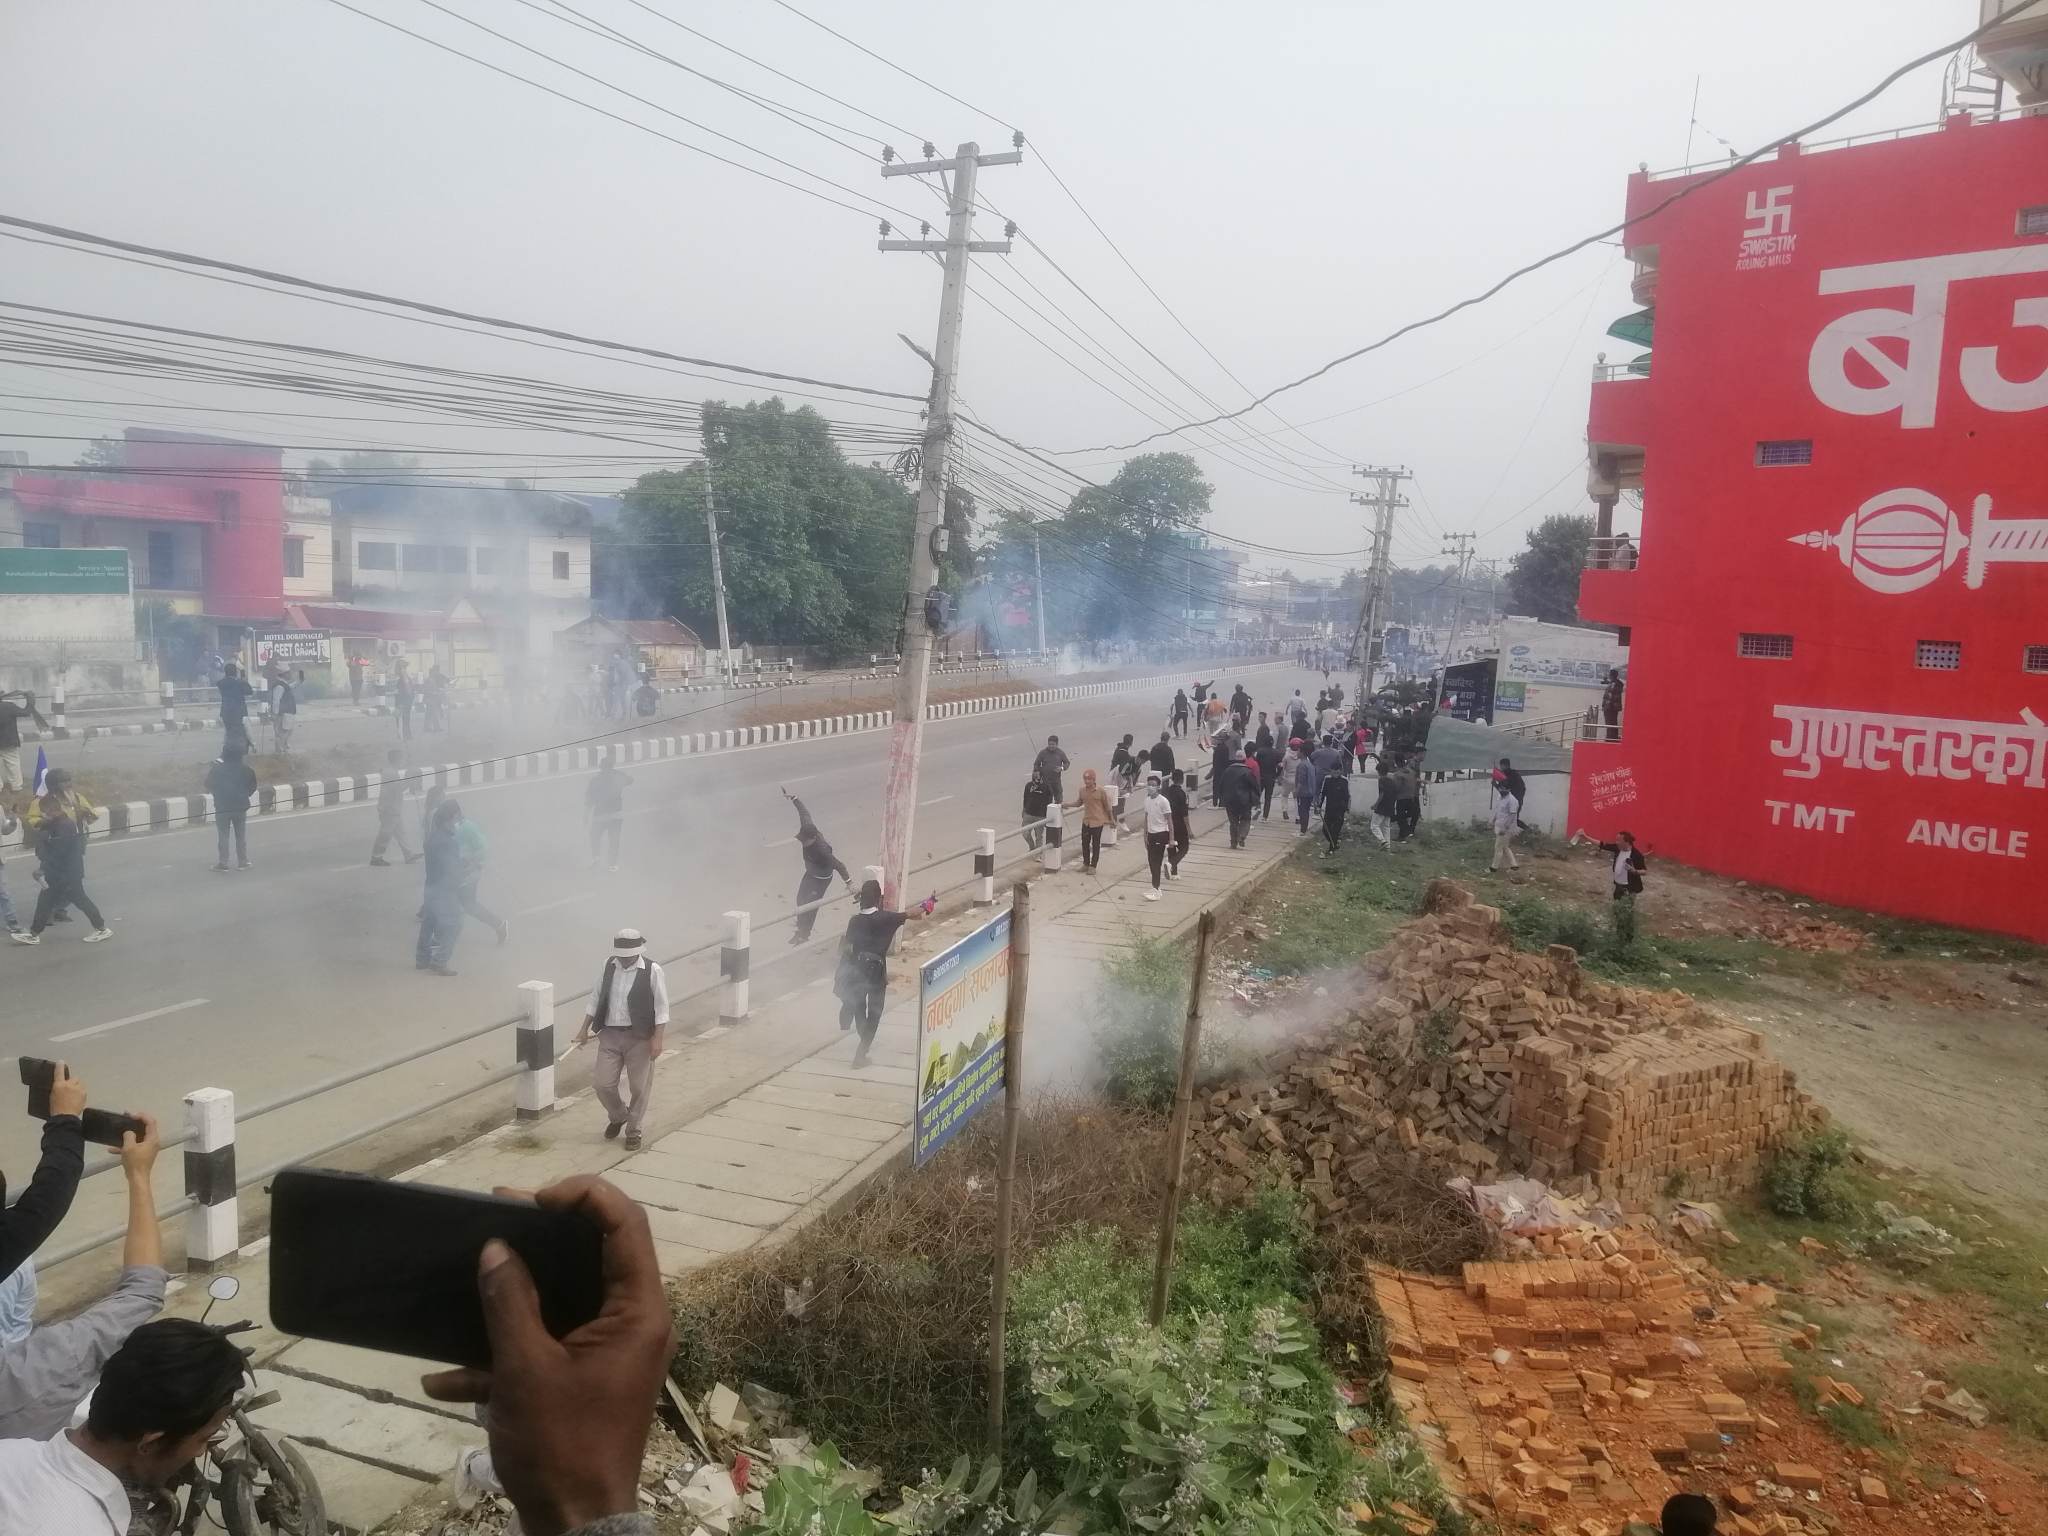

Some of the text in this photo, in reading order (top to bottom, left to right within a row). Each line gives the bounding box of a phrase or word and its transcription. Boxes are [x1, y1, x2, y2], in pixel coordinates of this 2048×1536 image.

[1739, 234, 1797, 257] SWASTIK
[1768, 253, 1792, 267] MILLS
[1770, 704, 2048, 789] गुणस्तरको
[1764, 800, 2029, 858] TMT ANGLE
